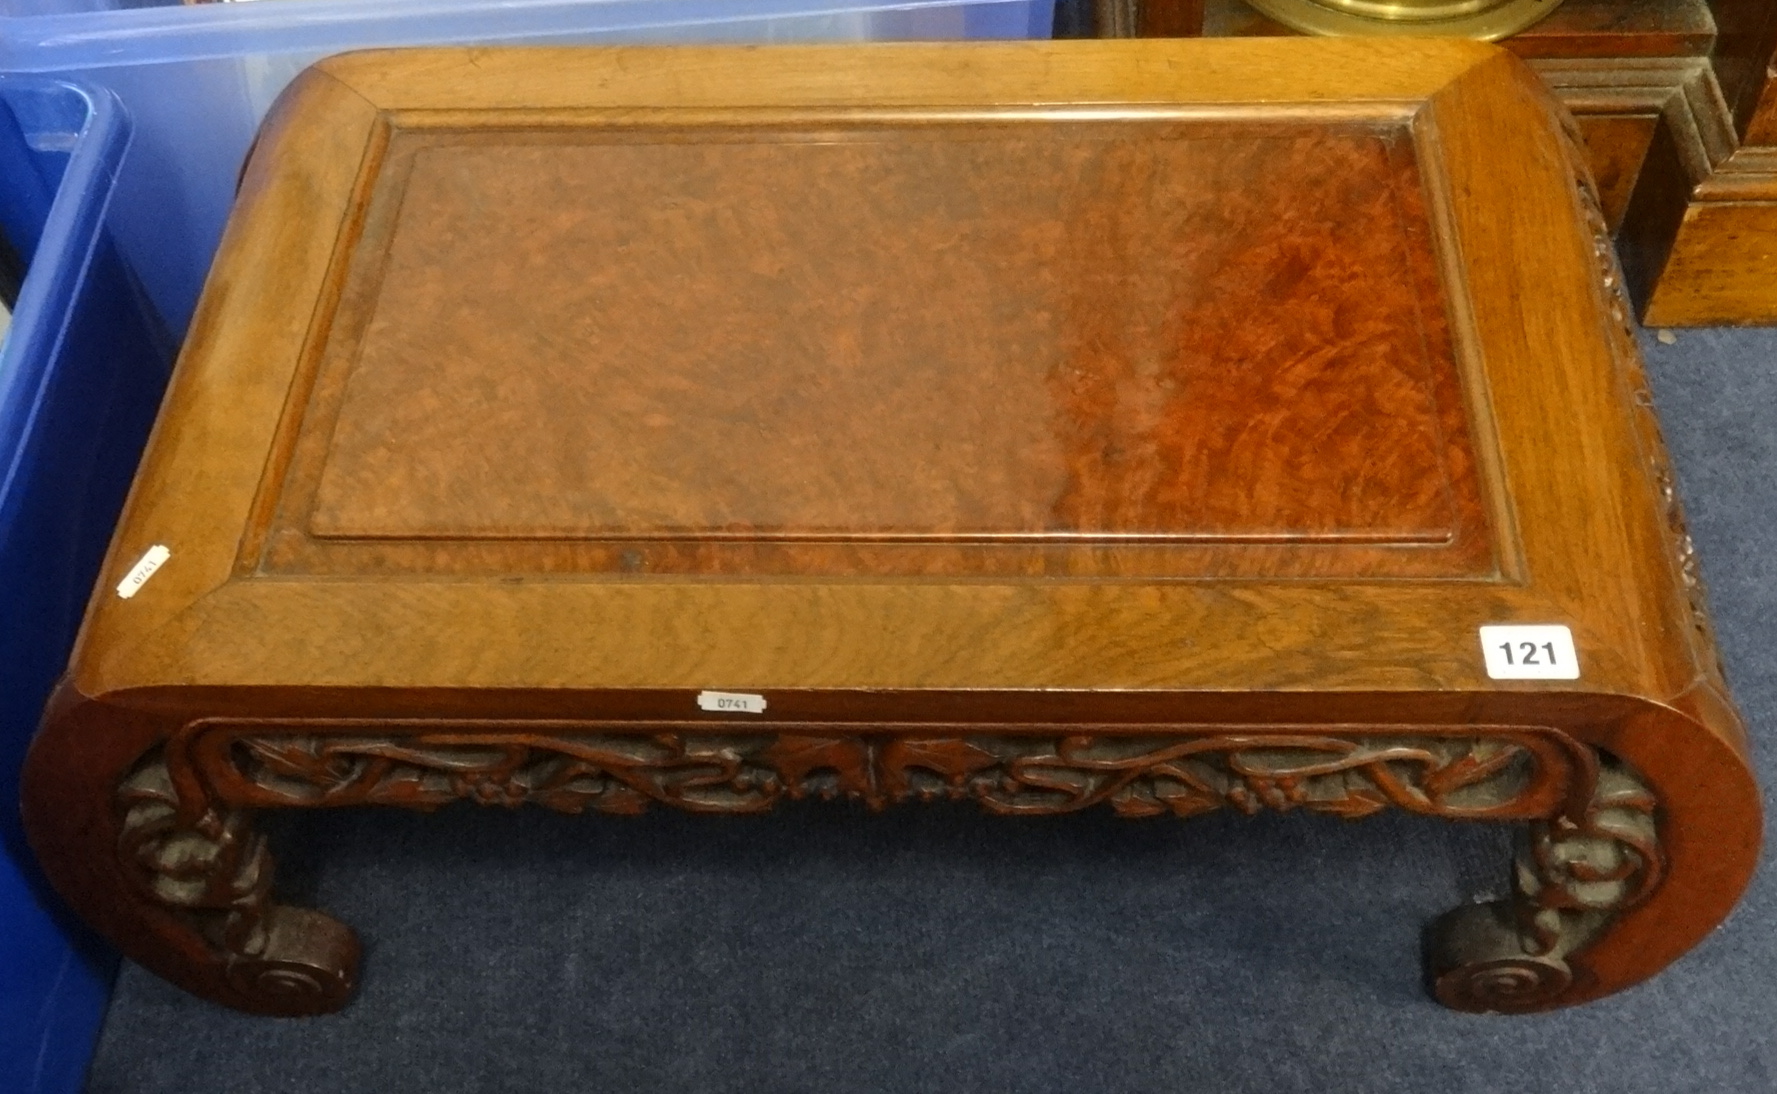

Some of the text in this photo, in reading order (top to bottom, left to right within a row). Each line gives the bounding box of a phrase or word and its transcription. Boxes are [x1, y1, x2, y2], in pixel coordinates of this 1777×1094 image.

[133, 560, 157, 585] 0741
[1499, 641, 1557, 665] 121
[717, 698, 748, 709] 0741
